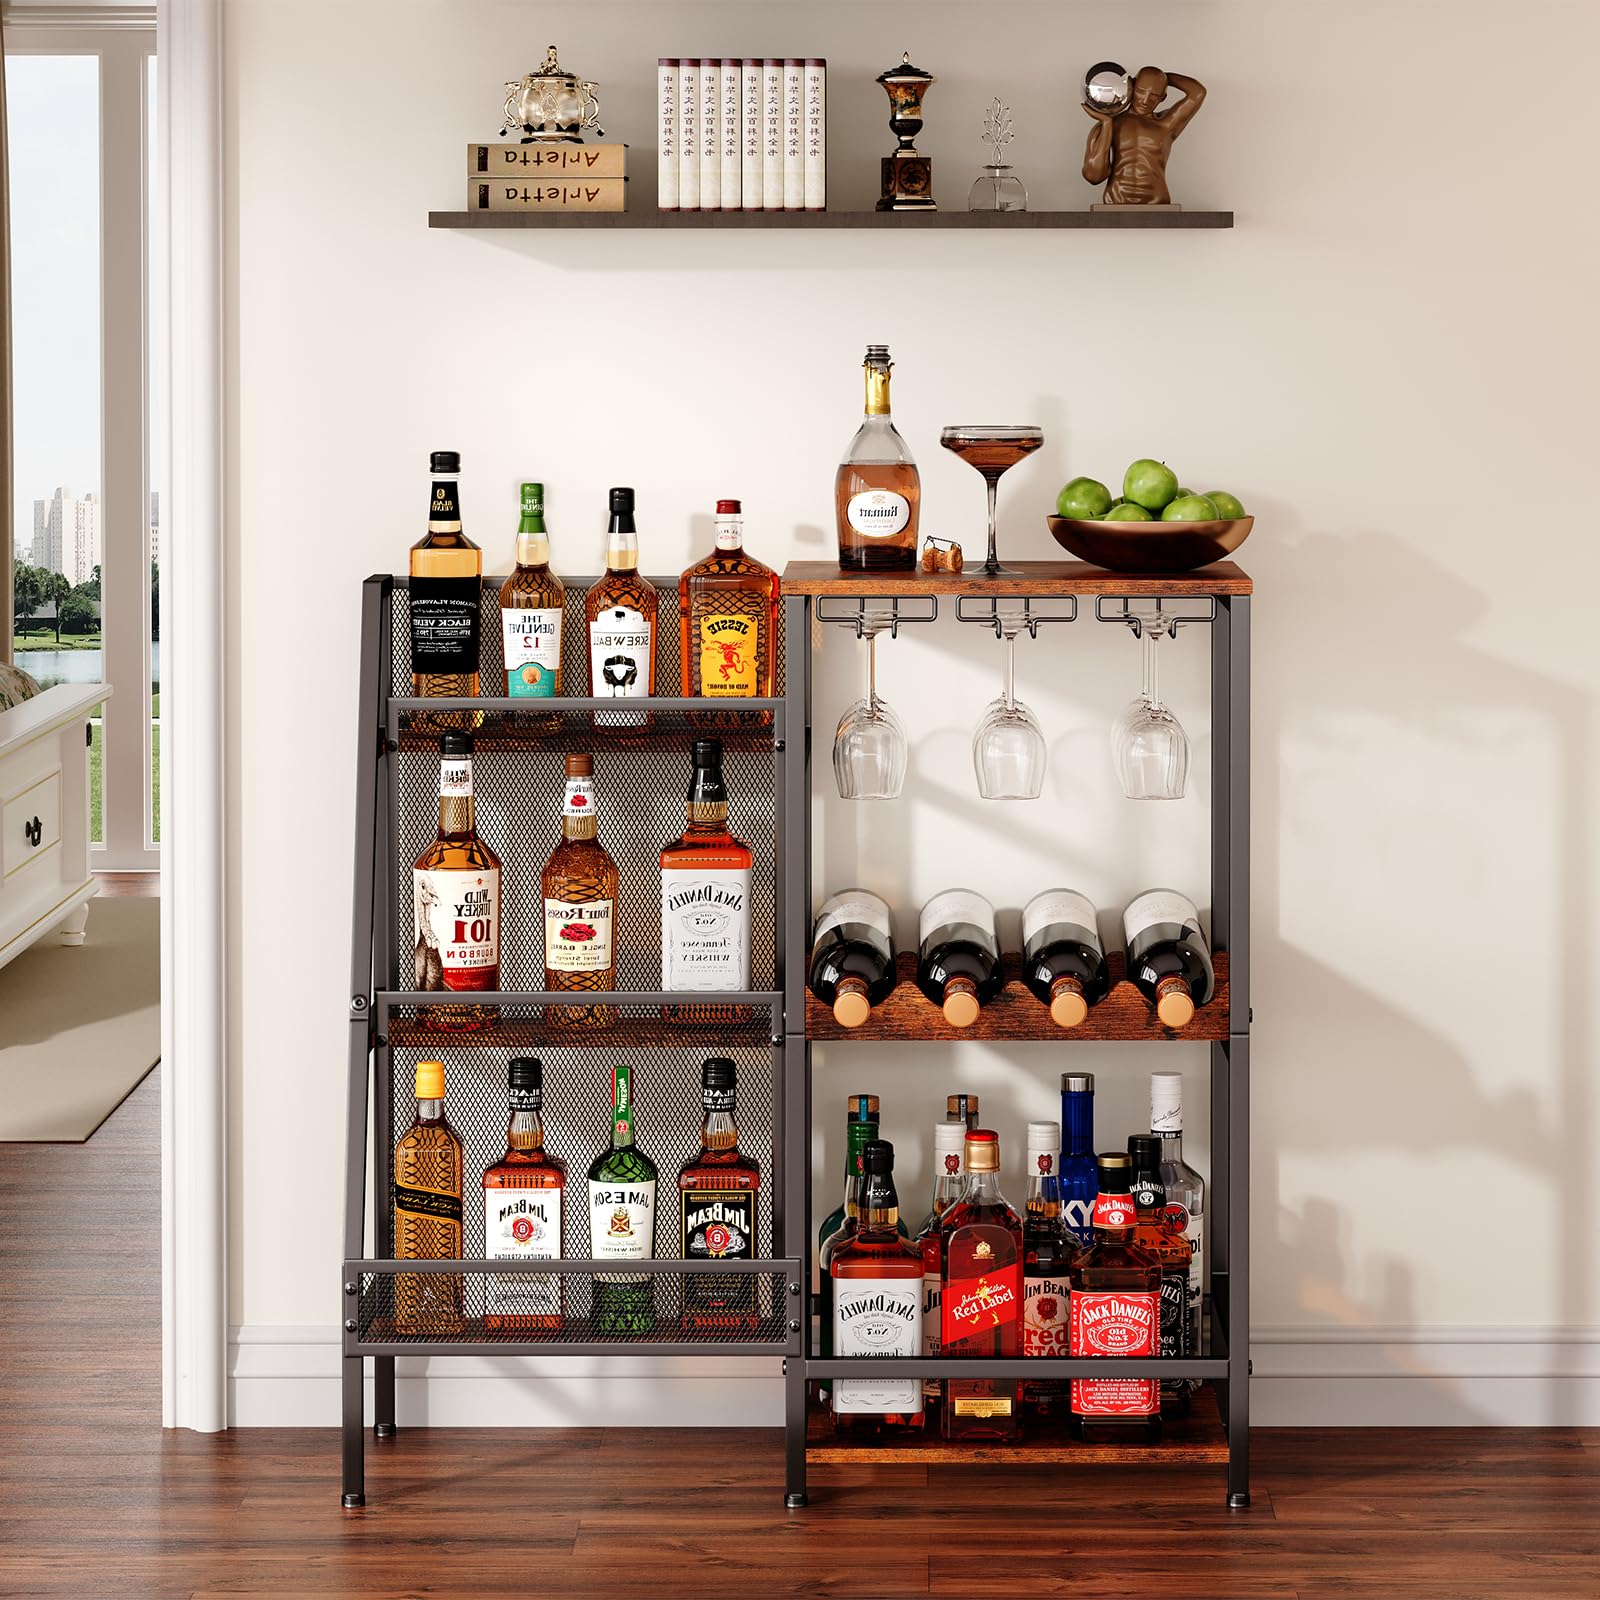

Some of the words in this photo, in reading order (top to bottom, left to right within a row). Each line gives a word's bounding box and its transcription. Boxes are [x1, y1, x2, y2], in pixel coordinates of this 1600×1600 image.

[504, 151, 600, 169] Arletta
[505, 188, 601, 205] Arletta
[1097, 1202, 1112, 1215] JACK
[952, 1302, 980, 1321] Red
[980, 1289, 1014, 1311] Label
[1083, 1304, 1112, 1326] JACK
[1110, 1299, 1153, 1326] DANIEL'S
[1102, 1317, 1116, 1325] OLD
[1117, 1317, 1133, 1325] TIME
[1024, 1323, 1070, 1347] red
